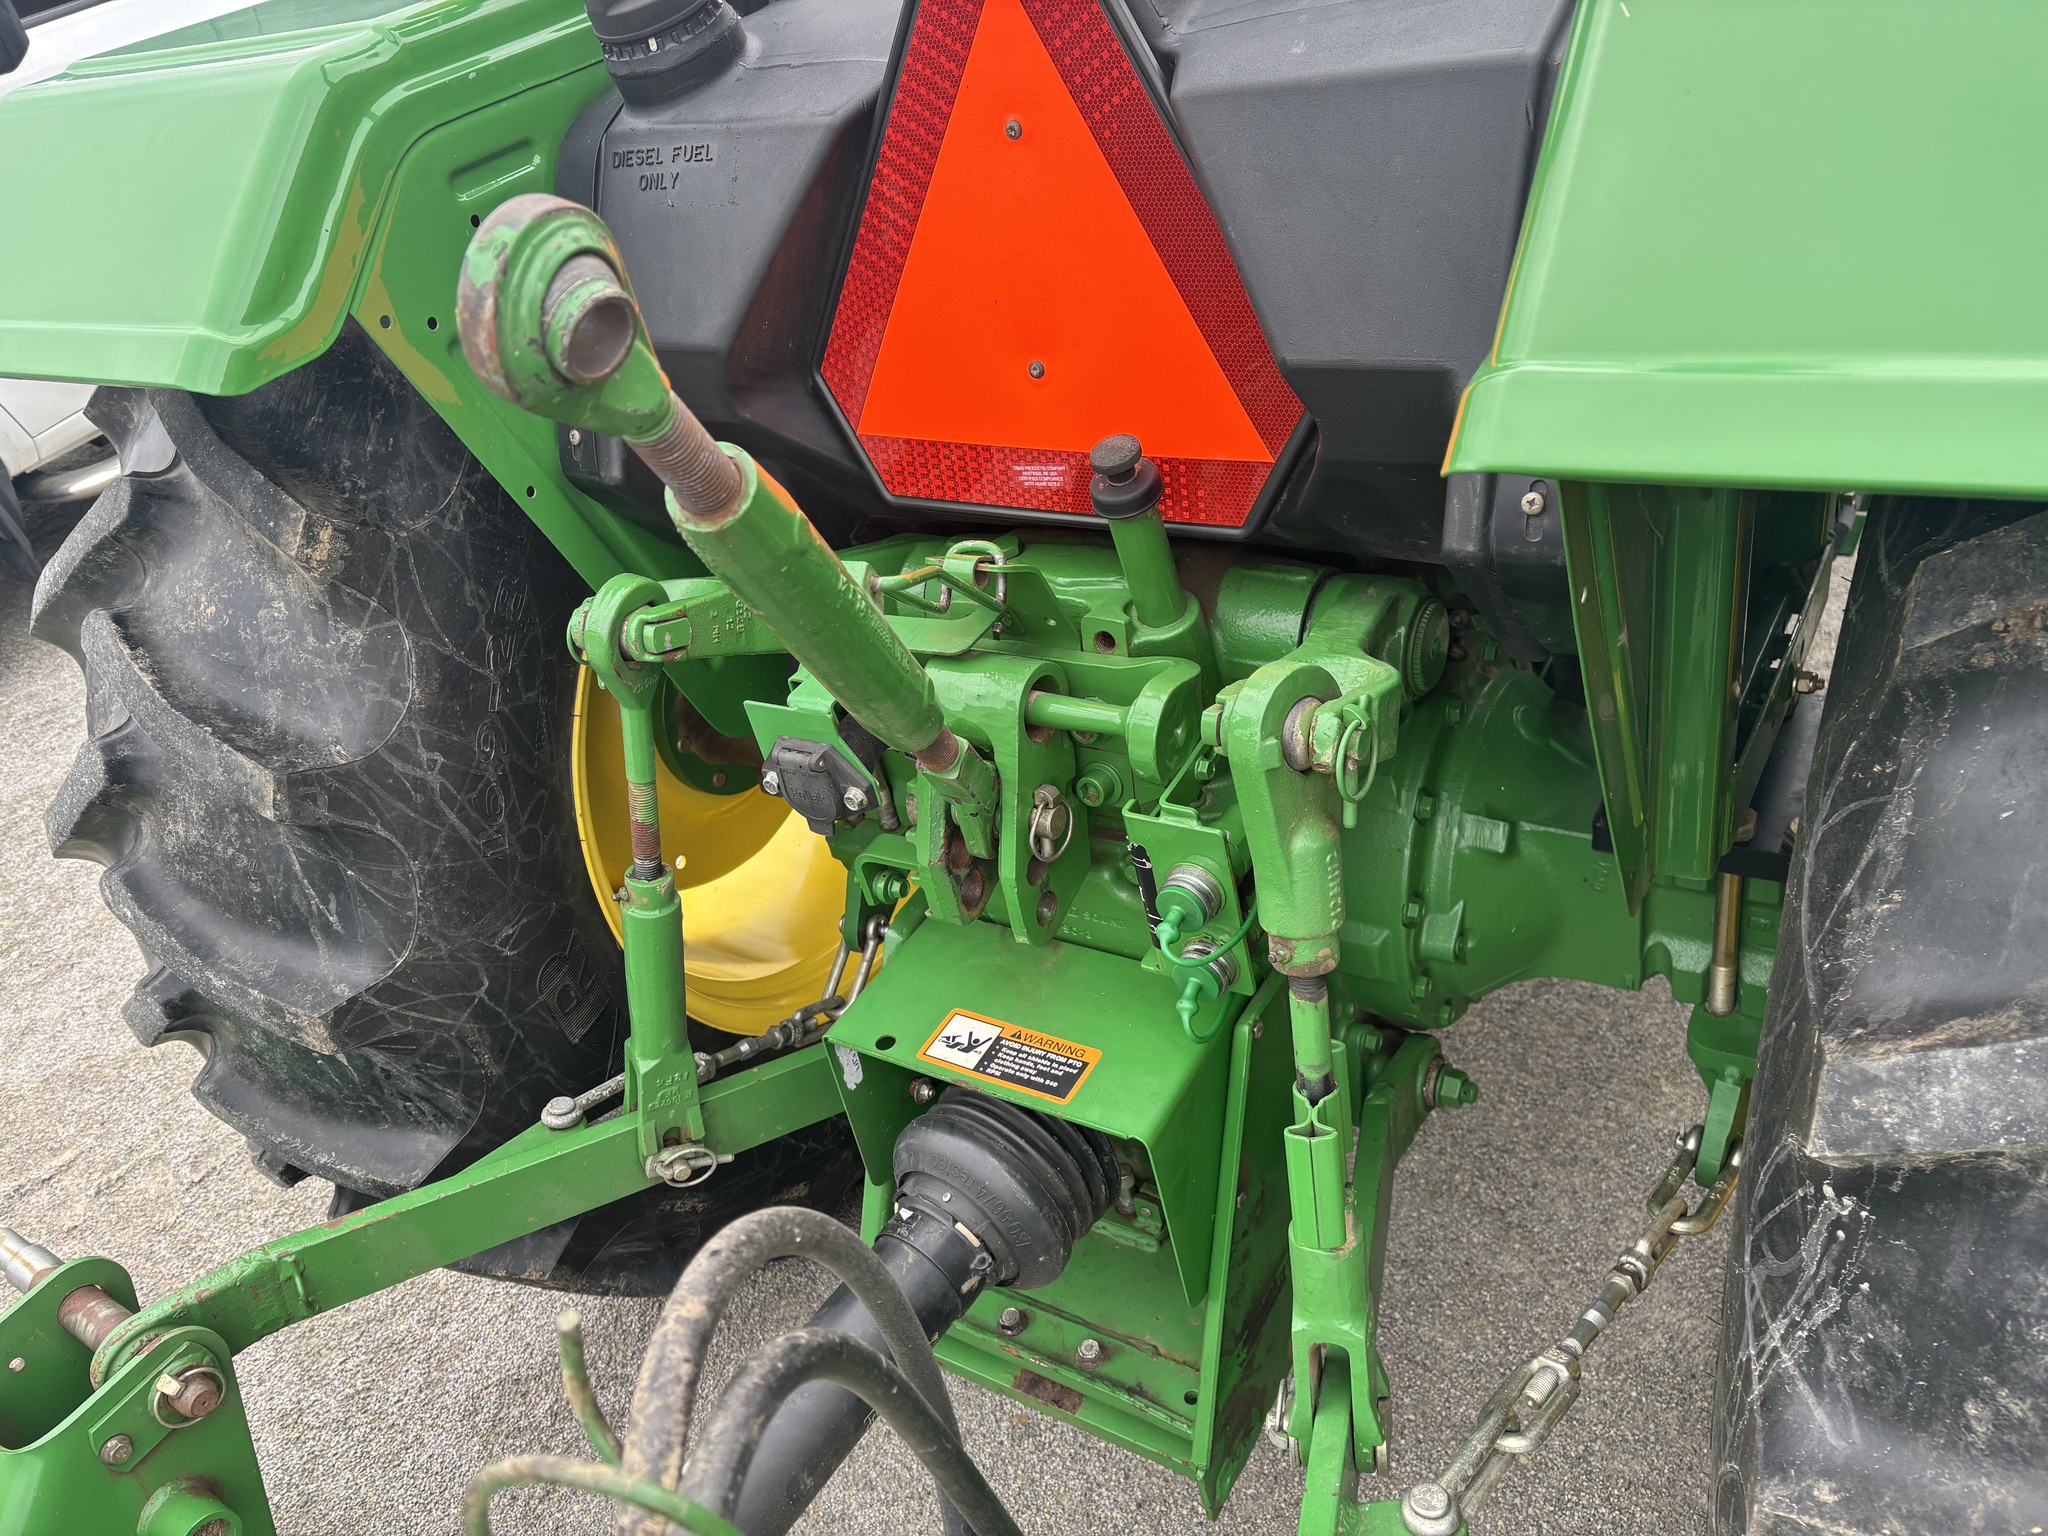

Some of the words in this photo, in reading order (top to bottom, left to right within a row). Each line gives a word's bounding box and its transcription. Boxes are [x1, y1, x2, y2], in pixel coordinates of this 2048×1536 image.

[612, 146, 664, 169] DIESEL
[671, 143, 714, 164] FUEL
[639, 171, 680, 192] ONLY
[999, 1039, 1022, 1049] AVOID
[1021, 1044, 1047, 1057] INJURY
[1046, 1051, 1067, 1063] FROM
[1067, 1057, 1083, 1068] PTO
[1024, 1032, 1086, 1058] WARNING
[994, 1058, 1020, 1071] clothing
[1019, 1066, 1038, 1075] away
[997, 1052, 1014, 1062] Keep
[1013, 1056, 1035, 1068] hands,
[1036, 1063, 1050, 1072] feet
[1050, 1068, 1064, 1076] and
[1001, 1047, 1018, 1057] Keep
[1027, 1053, 1051, 1066] shields
[1051, 1060, 1059, 1068] in
[985, 1067, 1002, 1077] RPM
[989, 1063, 1015, 1075] Operate
[1015, 1070, 1030, 1080] only
[1029, 1074, 1045, 1084] with
[974, 1184, 1015, 1224] 5674
[1007, 1221, 1032, 1247] ISO
